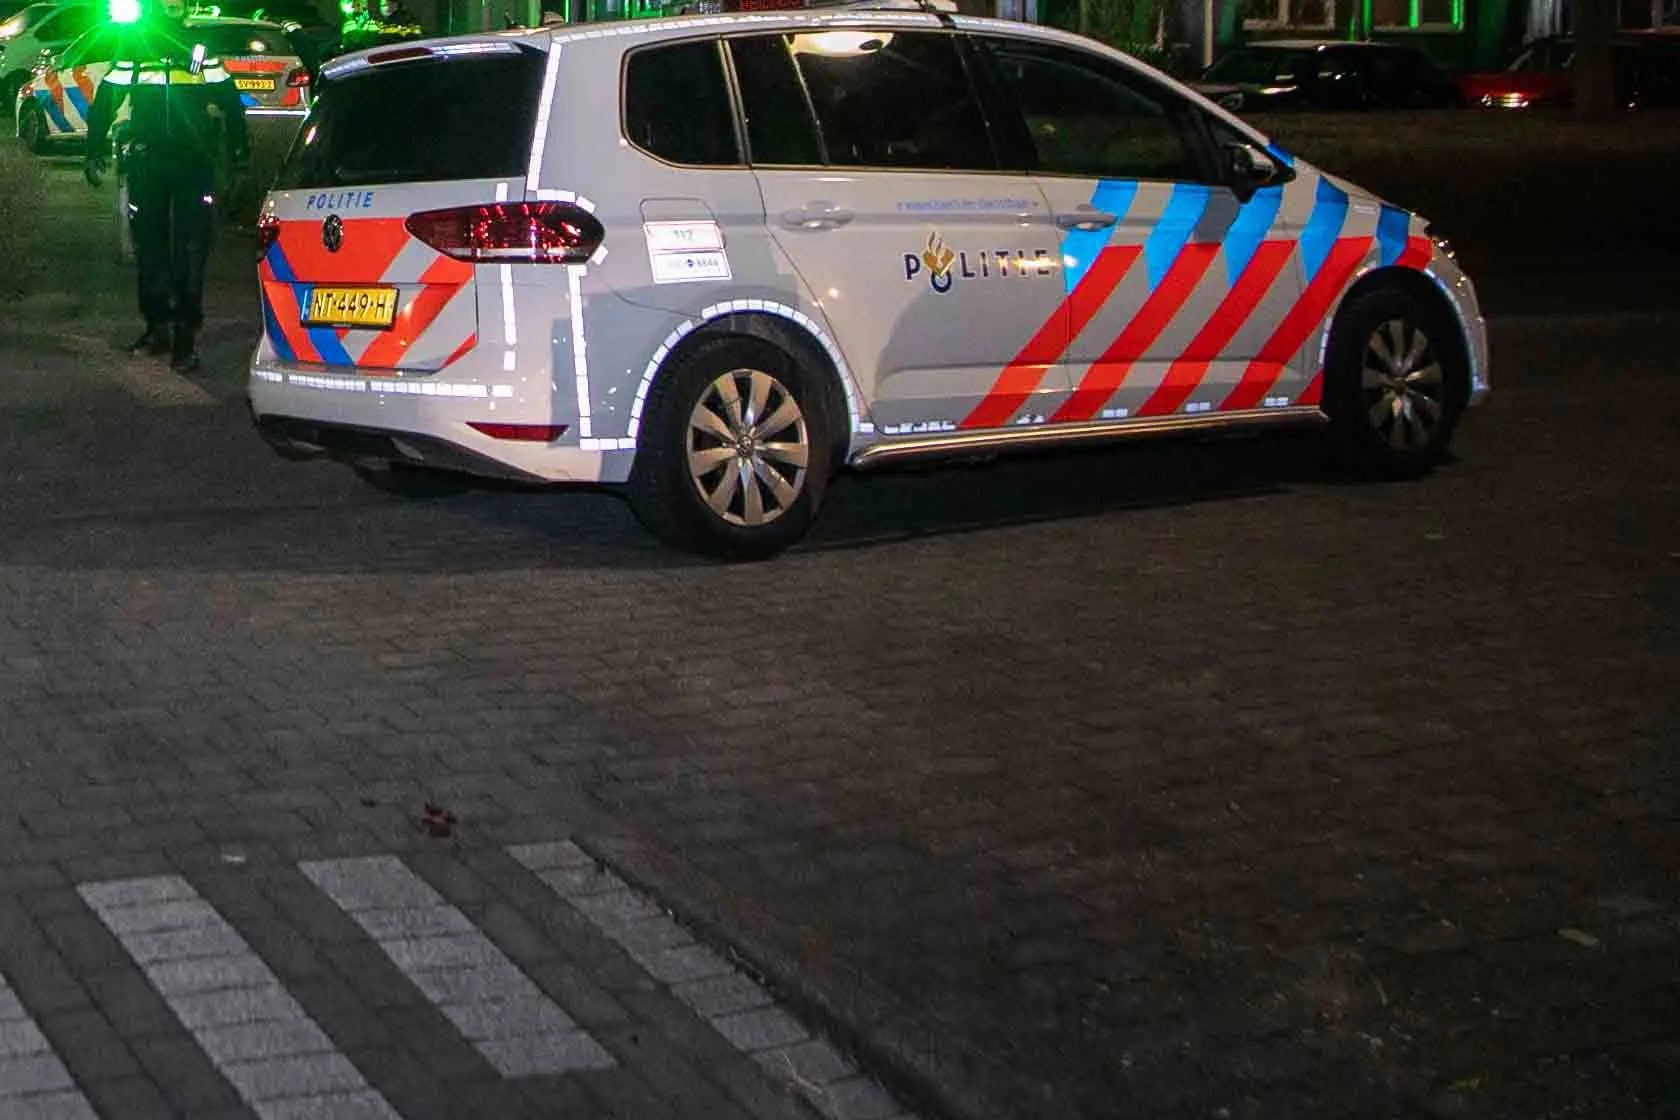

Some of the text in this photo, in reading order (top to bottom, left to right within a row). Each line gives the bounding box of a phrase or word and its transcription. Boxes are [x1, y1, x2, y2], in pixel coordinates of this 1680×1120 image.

[306, 191, 374, 209] POLITIE
[903, 248, 1051, 293] POLITIE
[314, 291, 389, 318] NT-449-H
